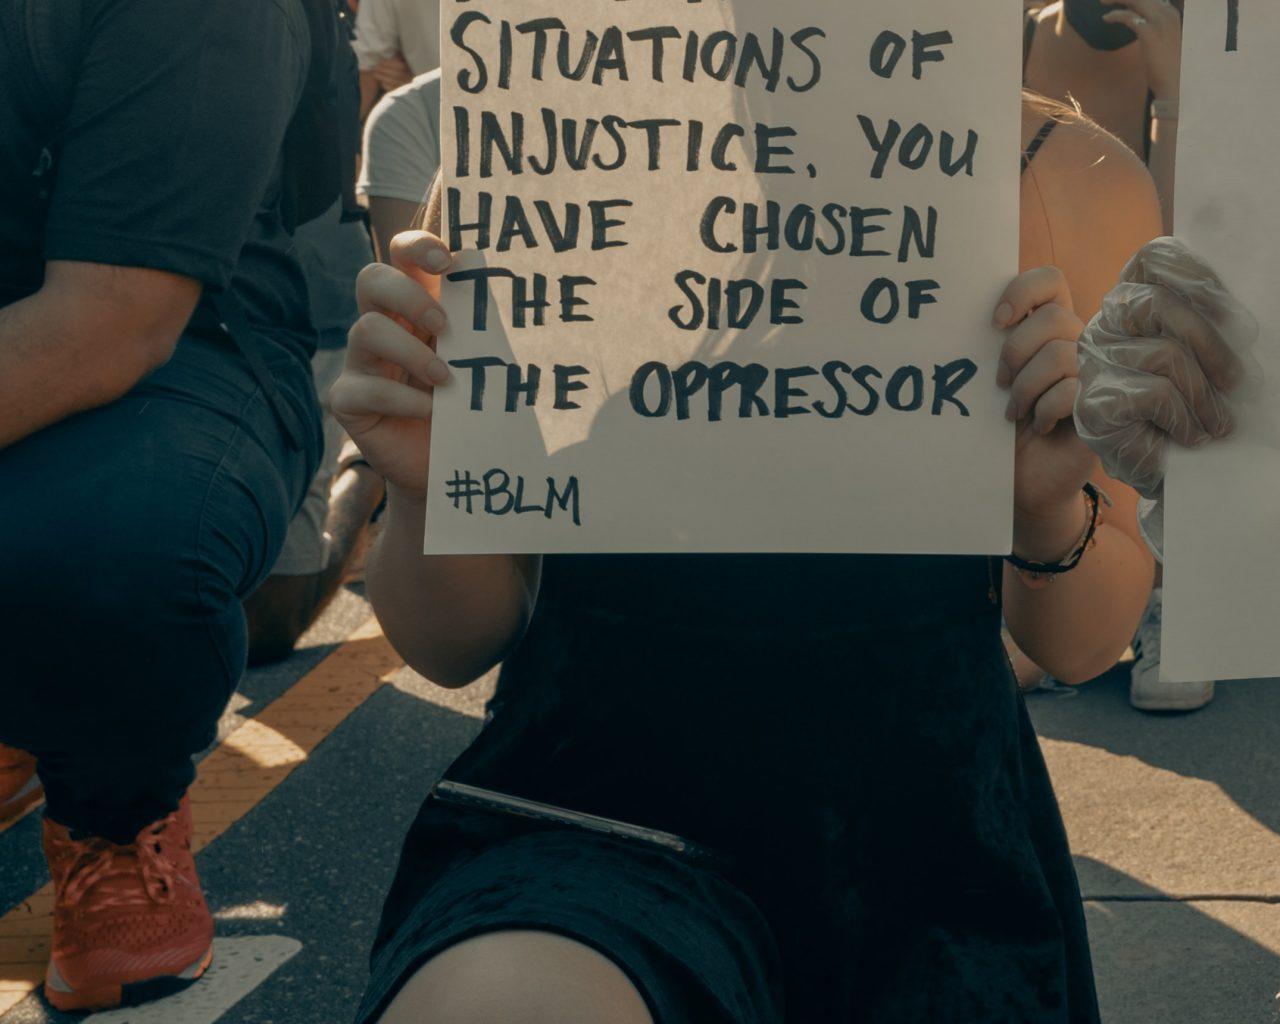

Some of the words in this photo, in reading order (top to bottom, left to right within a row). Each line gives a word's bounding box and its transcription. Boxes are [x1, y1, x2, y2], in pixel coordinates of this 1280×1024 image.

[449, 10, 827, 95] SITUATIONS
[869, 29, 954, 81] OF
[453, 105, 817, 182] INJUSTICE,
[856, 113, 980, 180] YOU
[446, 187, 634, 254] HAVE
[699, 194, 939, 264] CHOSEN
[446, 267, 598, 333] THE
[667, 270, 809, 332] SIDE
[860, 276, 941, 325] OF
[448, 356, 592, 414] THE
[628, 357, 979, 423] OPPRESSOR
[445, 467, 583, 527] #BLM
